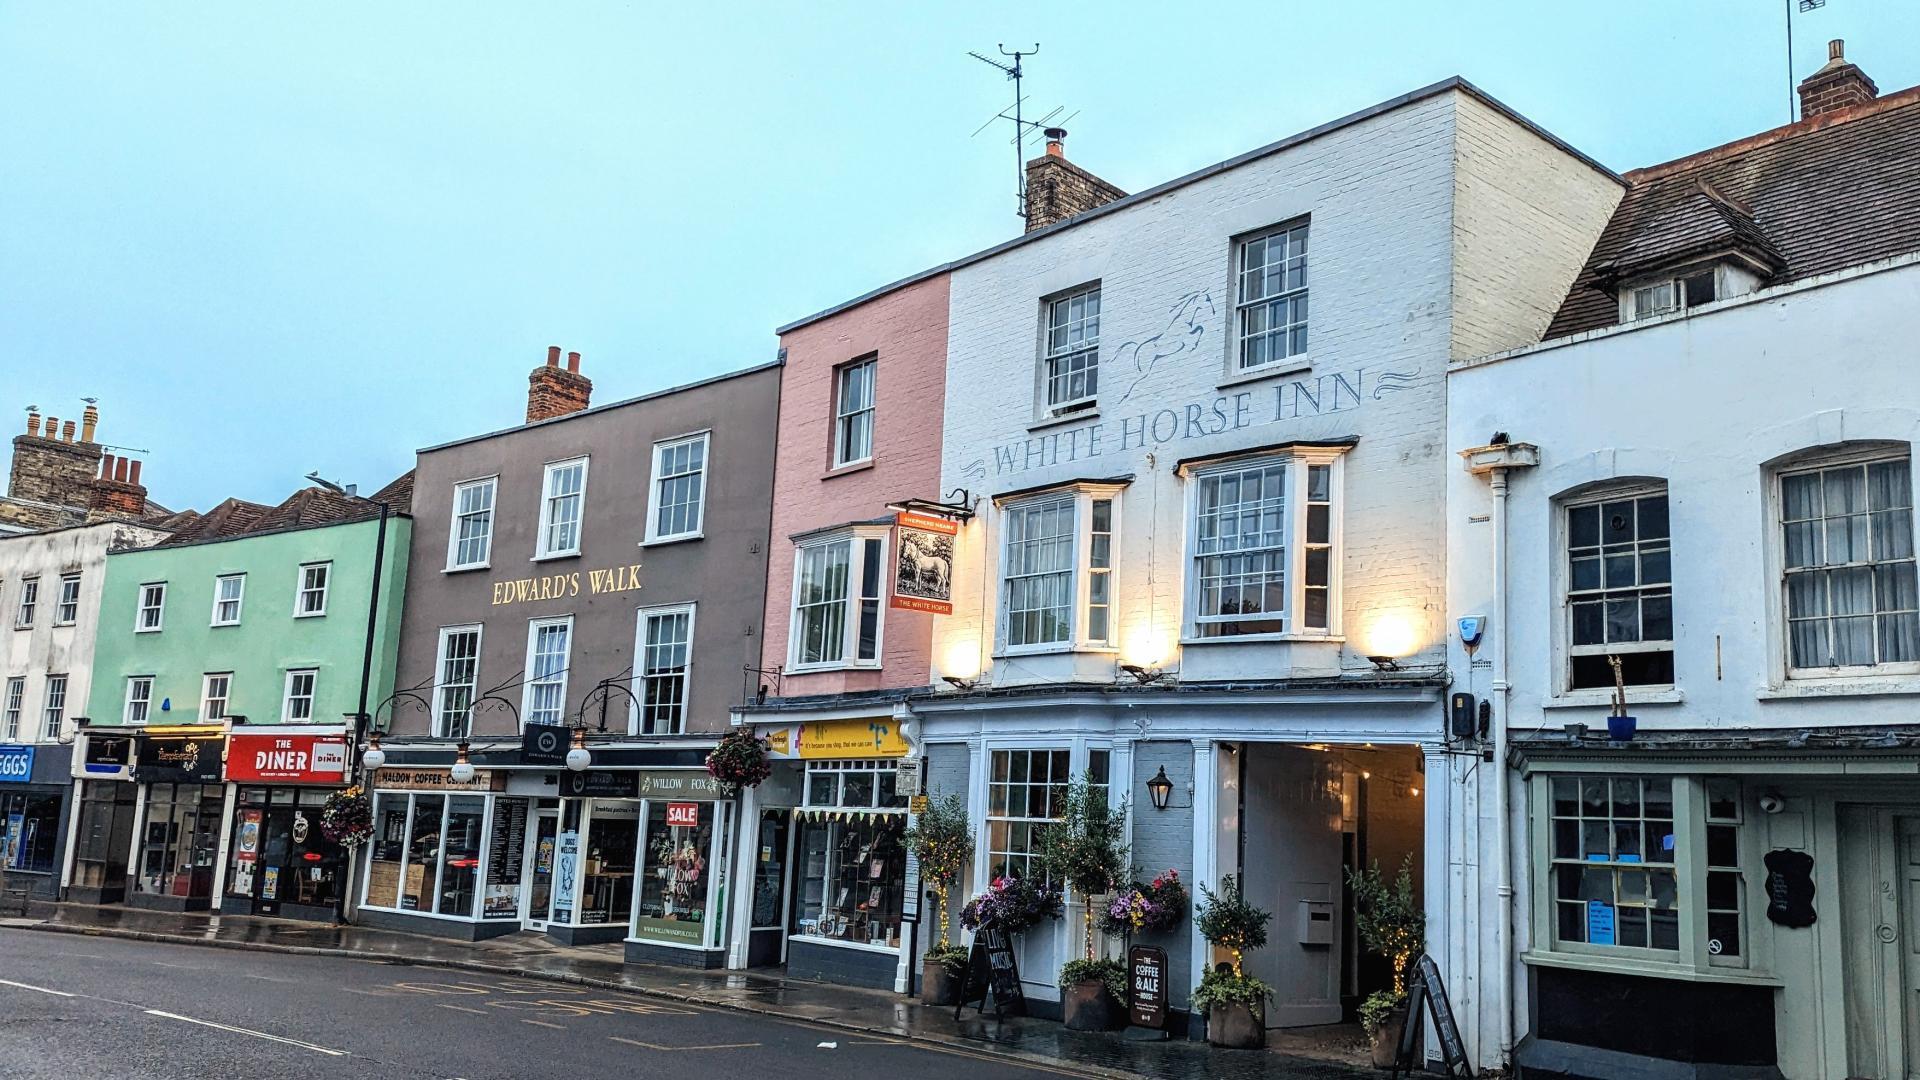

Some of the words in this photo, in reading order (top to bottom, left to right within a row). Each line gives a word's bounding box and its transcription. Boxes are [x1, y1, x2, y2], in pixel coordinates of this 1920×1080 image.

[993, 423, 1105, 476] WHITE
[1120, 391, 1252, 451] HORSE
[1272, 367, 1365, 422] INN
[491, 572, 580, 606] EDWARD'S
[588, 564, 643, 595] WALK
[911, 602, 930, 610] WHITE
[931, 604, 950, 612] HORSE
[275, 739, 292, 749] THE
[256, 751, 308, 770] DINER
[383, 772, 411, 784] MALDON
[415, 773, 442, 785] COFFEE
[446, 774, 483, 785] CANY
[653, 778, 683, 789] WILLOW
[691, 779, 706, 789] FOX
[668, 807, 696, 822] SALE
[1143, 956, 1152, 964] THE
[1135, 964, 1159, 978] COFFEE
[1140, 992, 1154, 1000] HOUSE
